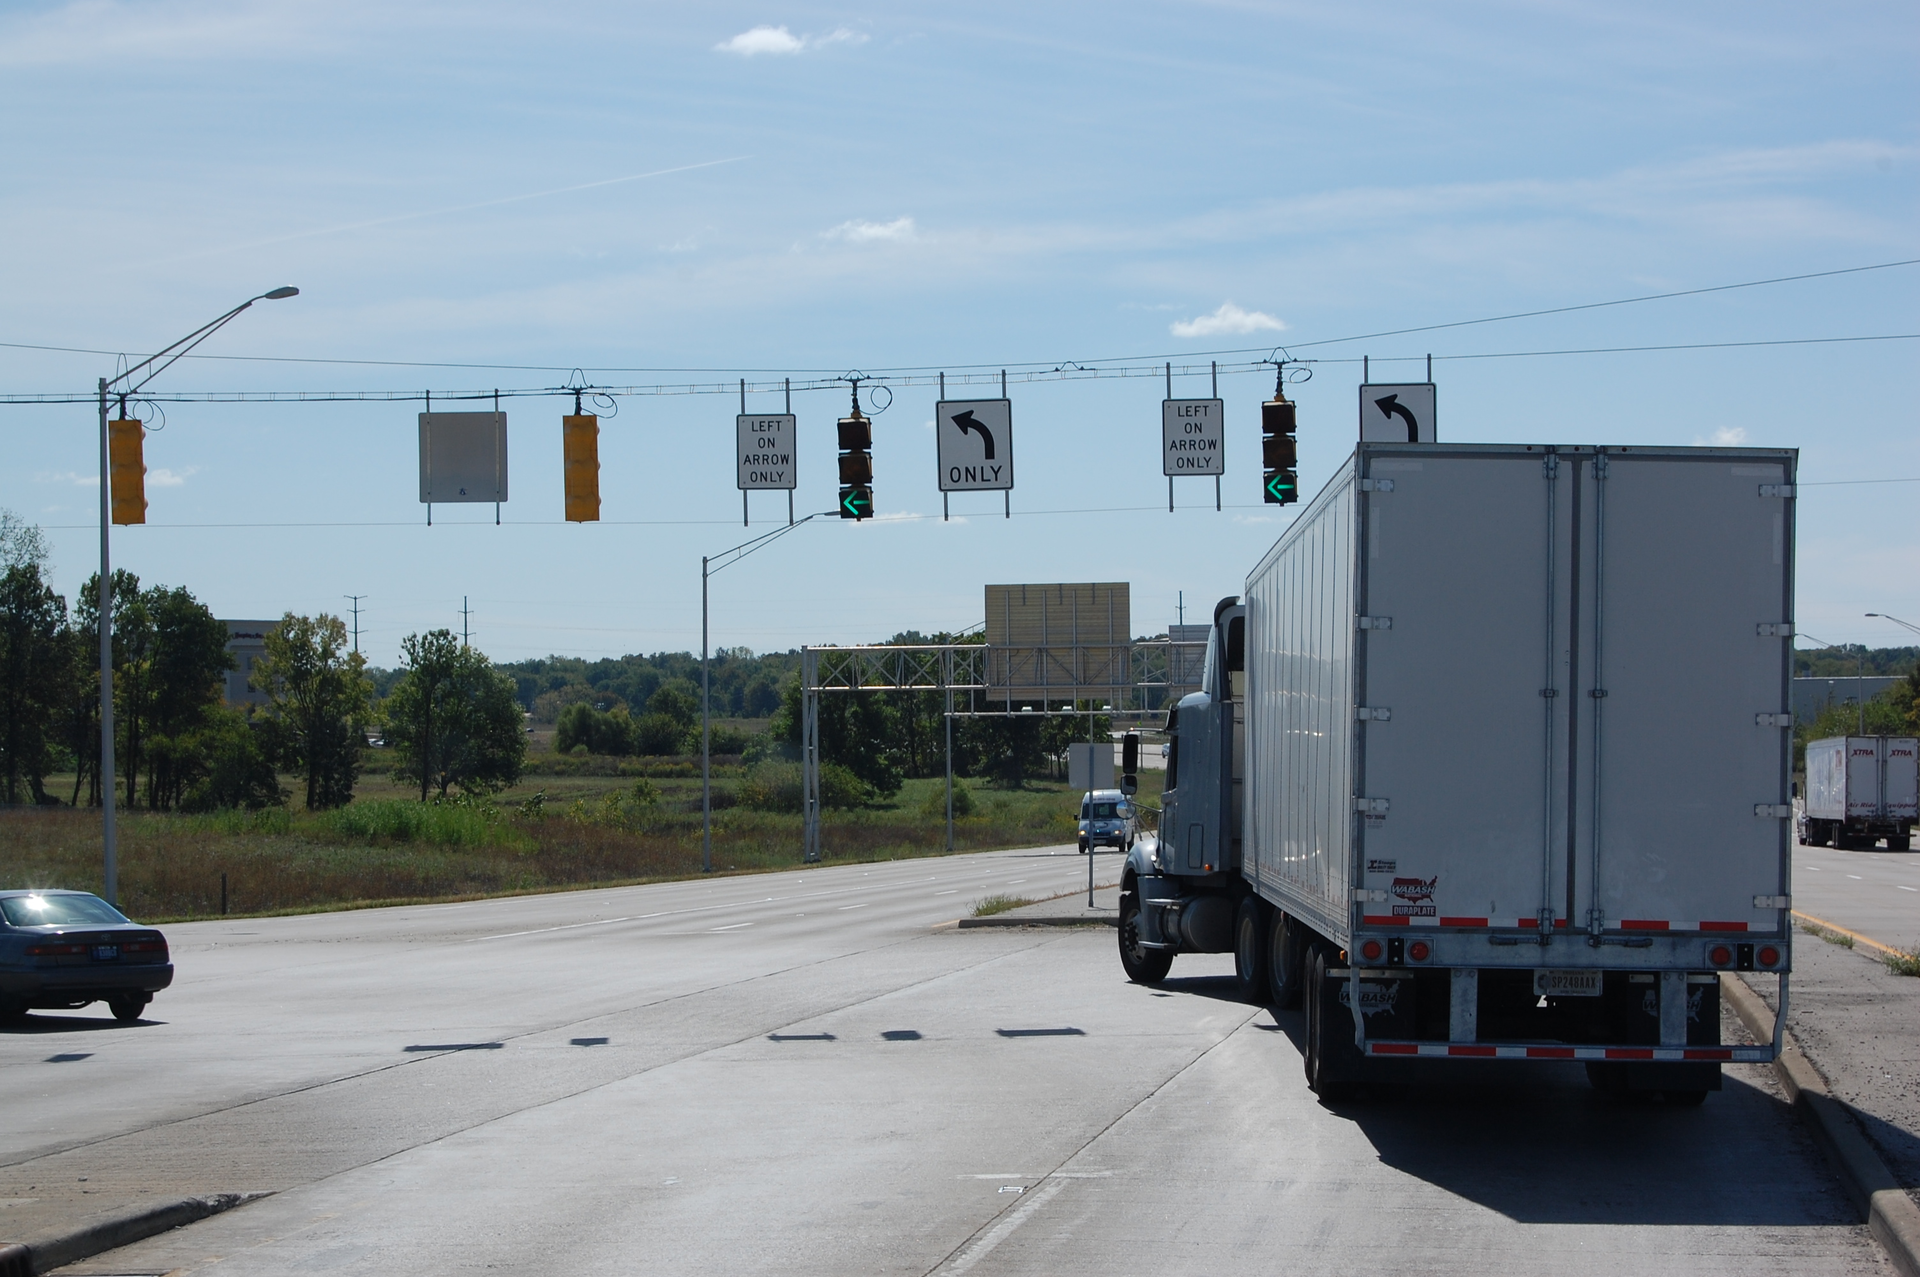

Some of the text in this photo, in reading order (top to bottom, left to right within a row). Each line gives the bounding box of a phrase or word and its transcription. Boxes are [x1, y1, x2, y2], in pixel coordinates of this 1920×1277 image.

[1177, 405, 1209, 418] LEFT
[751, 420, 782, 433] LEFT
[1184, 422, 1203, 434] ON
[757, 437, 776, 449] ON
[1169, 439, 1218, 451] ARROW
[743, 453, 790, 466] ARROW
[1176, 456, 1212, 469] ONLY
[749, 471, 785, 483] ONLY
[949, 465, 1003, 483] ONLY
[1851, 748, 1874, 757] XTRA
[1889, 749, 1912, 758] XTRA
[1392, 885, 1435, 894] WABASH
[1393, 906, 1435, 916] DURAPLATE
[1551, 976, 1596, 989] SP248AAX
[1340, 993, 1396, 1003] WBASH
